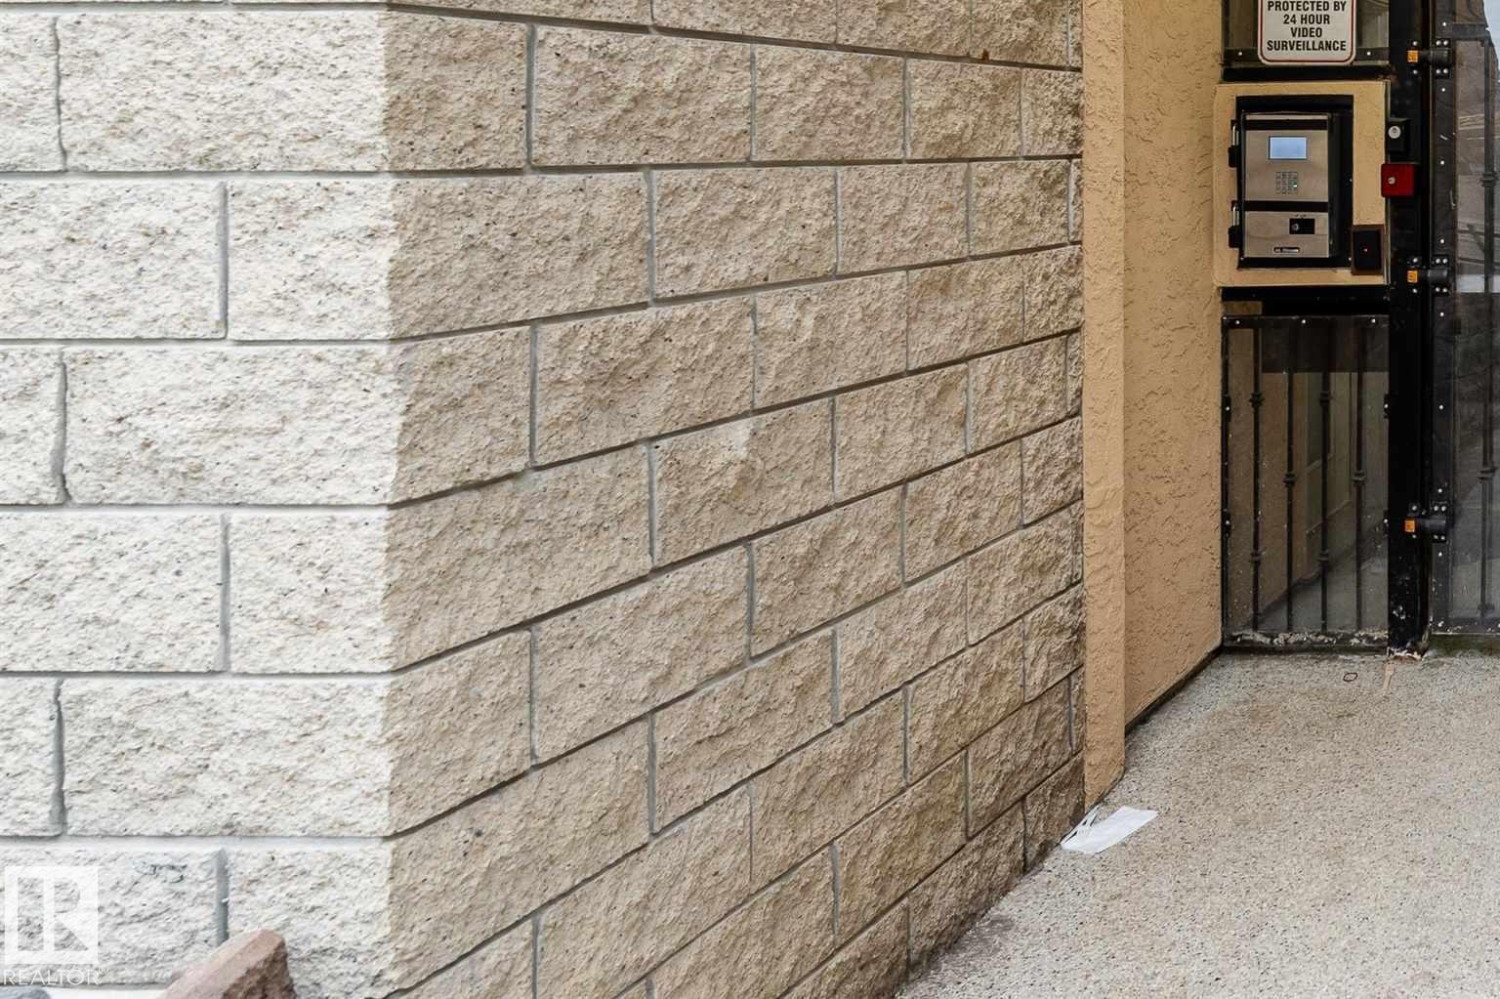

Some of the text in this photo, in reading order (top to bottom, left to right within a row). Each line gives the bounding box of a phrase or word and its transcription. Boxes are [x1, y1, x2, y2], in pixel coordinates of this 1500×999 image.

[1267, 1, 1347, 11] PROTECTED BY
[1283, 14, 1330, 24] 24 HOUR
[1290, 27, 1322, 37] VIDEO
[1266, 40, 1346, 51] SURVEILLANCE
